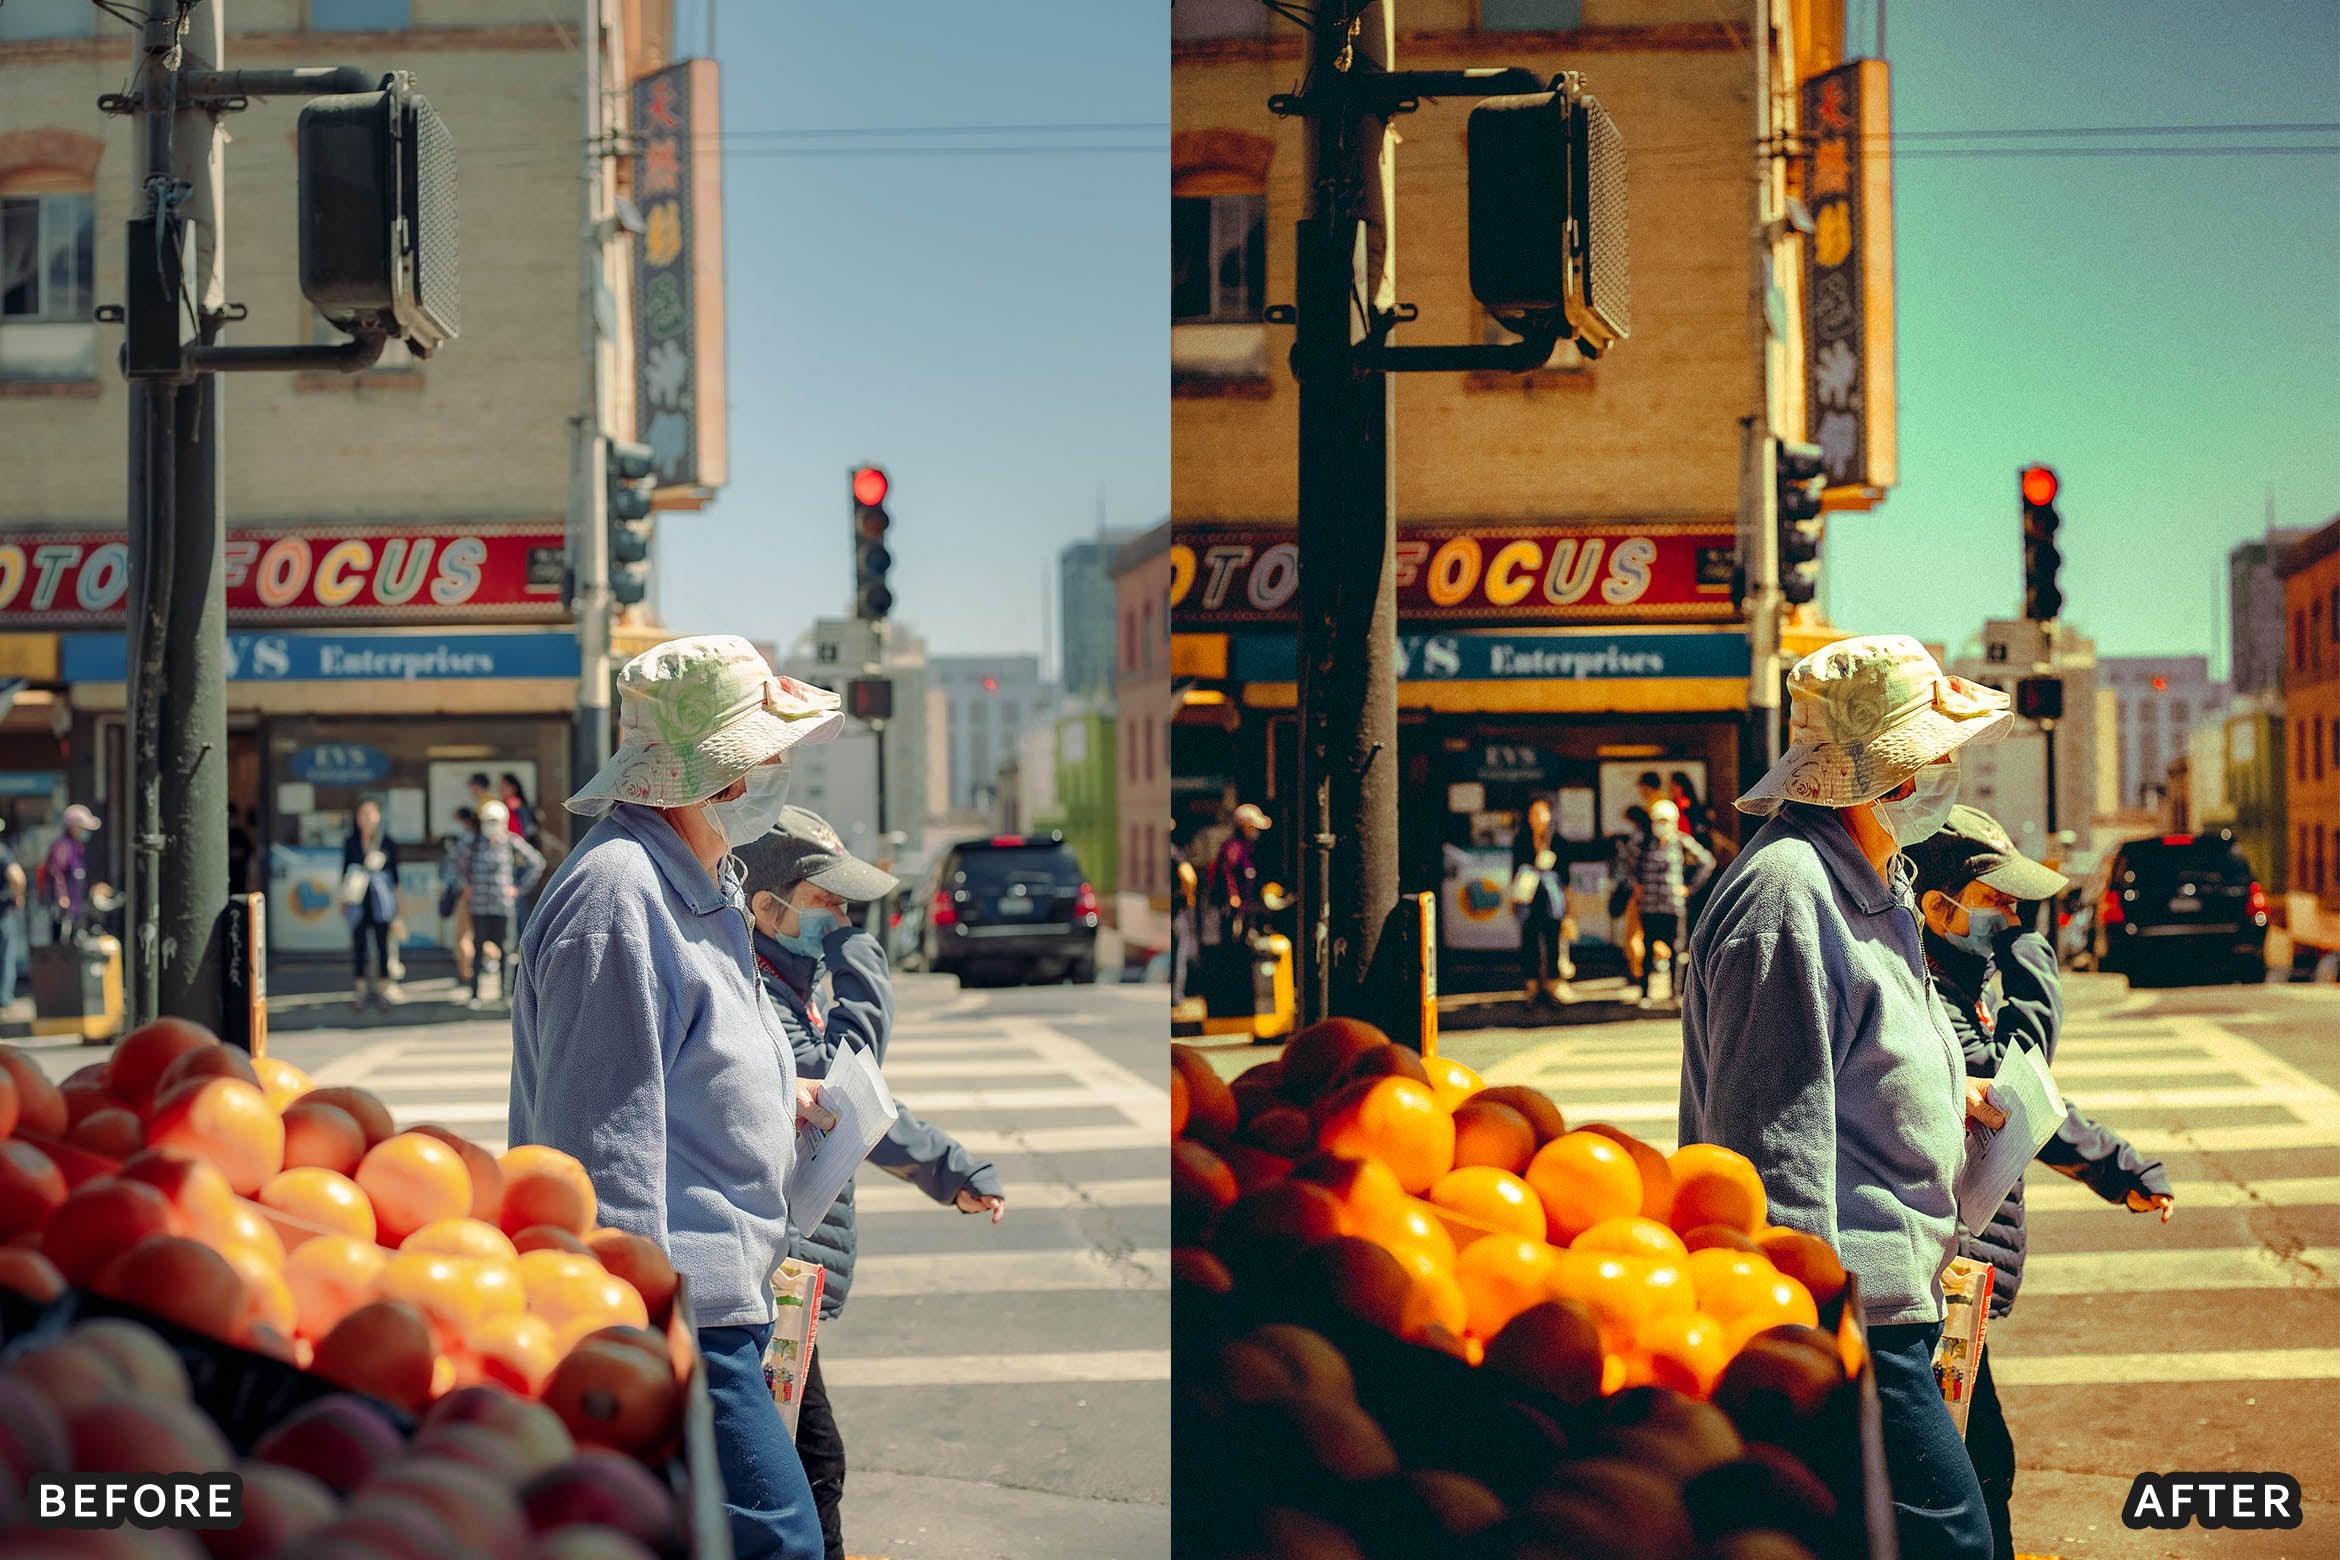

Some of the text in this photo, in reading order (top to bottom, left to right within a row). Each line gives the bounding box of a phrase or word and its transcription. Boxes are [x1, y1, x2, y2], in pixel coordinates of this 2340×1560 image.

[225, 536, 488, 609] FOCUS
[1396, 536, 1657, 609] FOCUS
[319, 643, 494, 680] Enterprises
[1490, 643, 1665, 680] Enterprises
